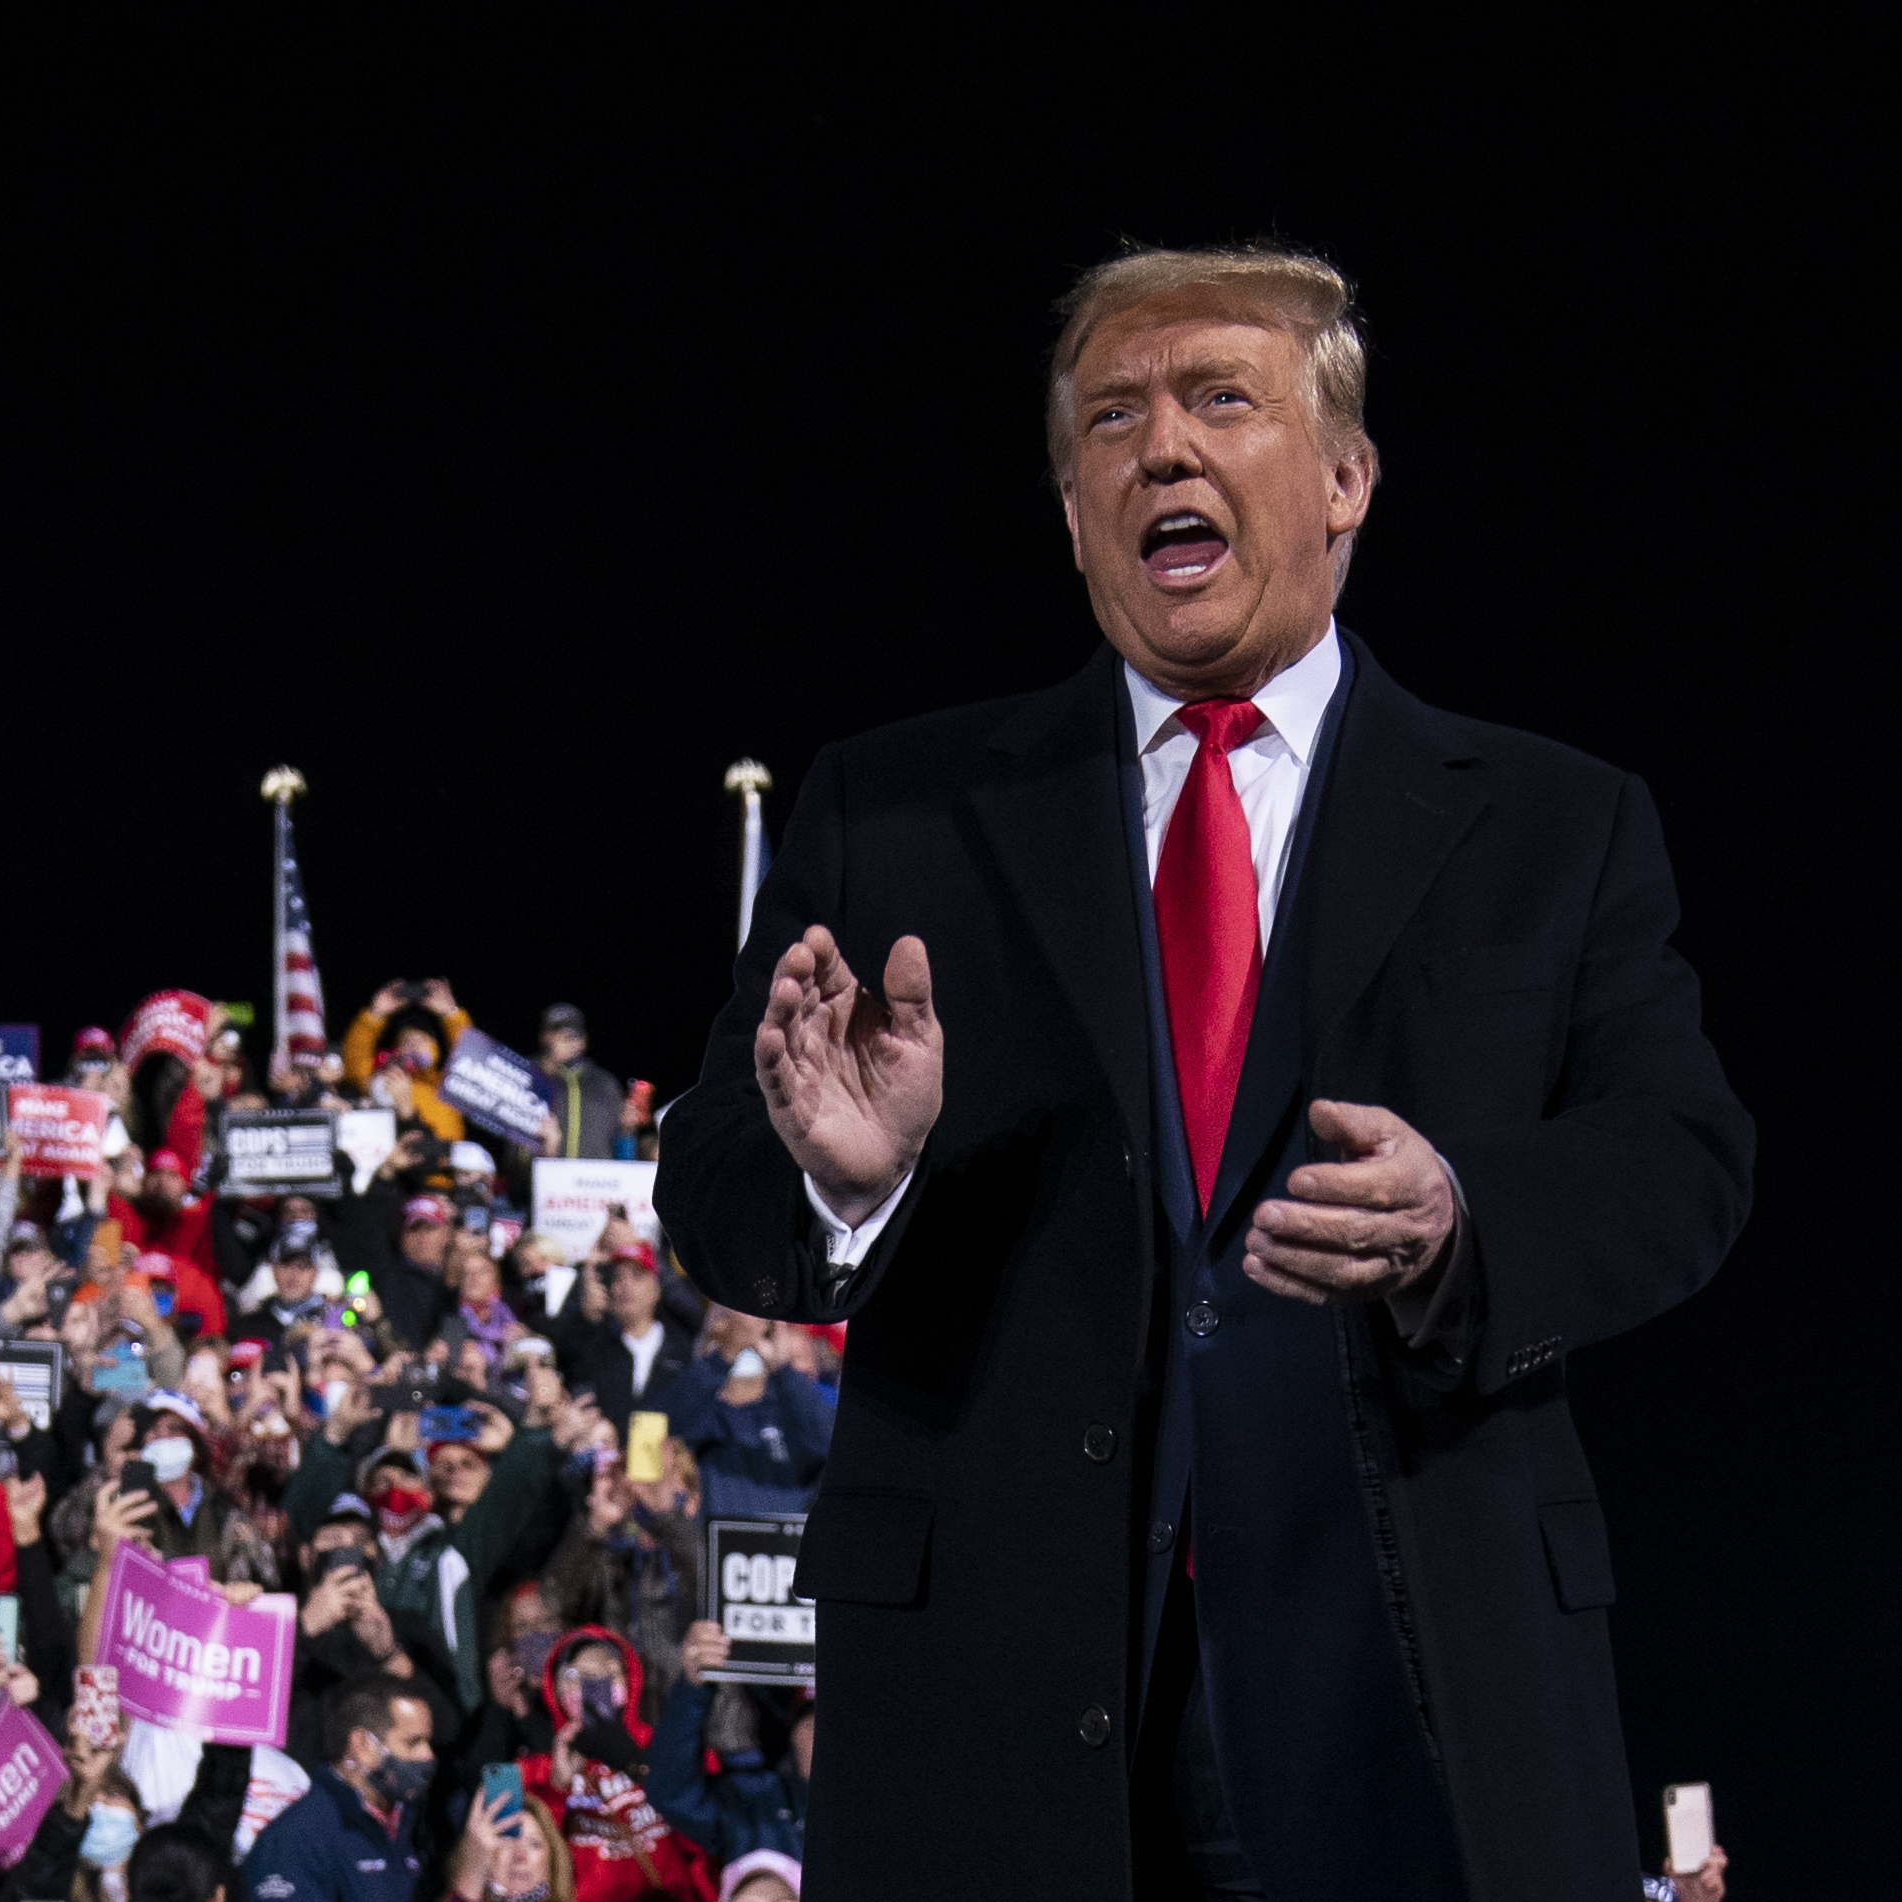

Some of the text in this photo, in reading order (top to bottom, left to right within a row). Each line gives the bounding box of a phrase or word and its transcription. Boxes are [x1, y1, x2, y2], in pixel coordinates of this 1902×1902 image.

[9, 1114, 104, 1143] ERICA
[223, 1126, 288, 1158] COPS
[722, 1551, 797, 1604] COP
[121, 1588, 262, 1685] Women
[731, 1612, 786, 1633] FOR
[125, 1644, 244, 1701] FOR TRUMP
